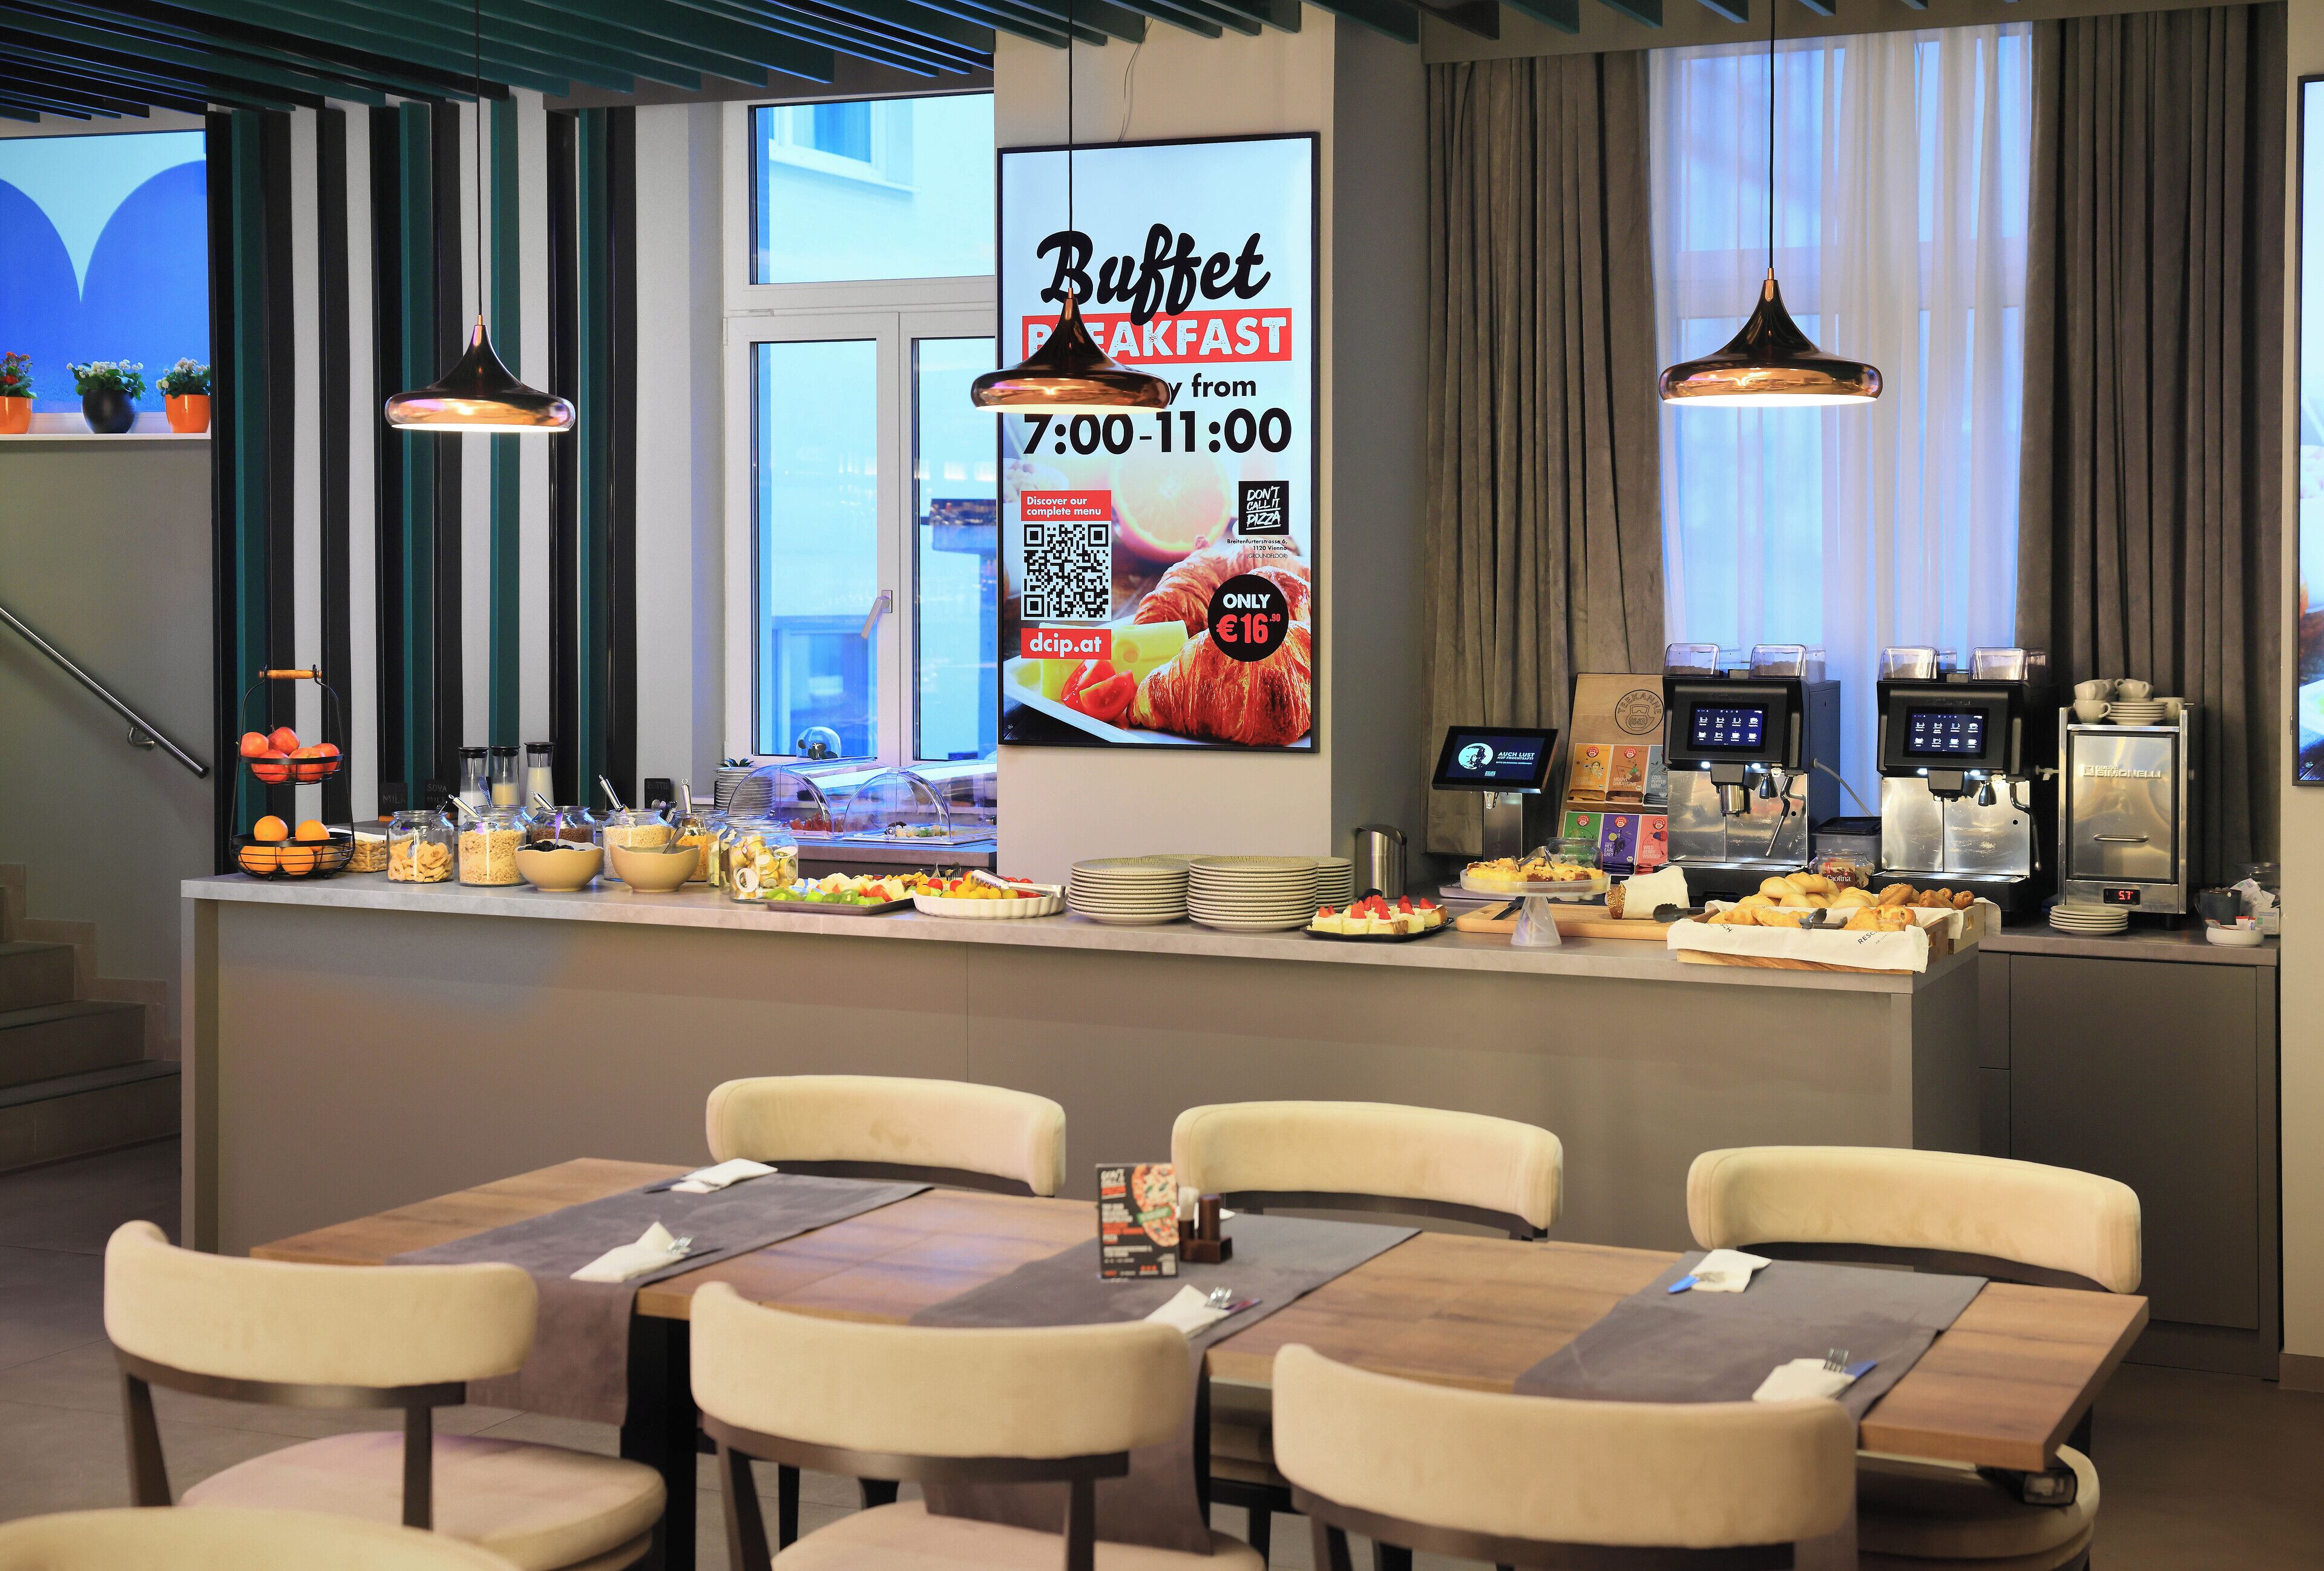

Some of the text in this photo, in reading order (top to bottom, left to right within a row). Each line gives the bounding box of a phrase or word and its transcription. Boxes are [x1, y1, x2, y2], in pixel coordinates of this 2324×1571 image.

[1037, 223, 1271, 326] Buffet
[1028, 317, 1287, 356] BEAKFAST
[1191, 373, 1256, 398] from
[1026, 496, 1068, 506] Discover
[1247, 486, 1281, 501] DON'T
[1026, 506, 1071, 518] complete
[1247, 498, 1281, 511] CALL IT
[1246, 511, 1281, 527] PIZZA
[1223, 593, 1270, 608] ONLY
[1029, 632, 1102, 657] dcip.at
[1618, 693, 1662, 714] TEEKANNE
[2096, 769, 2162, 778] SIMONELLI
[427, 783, 447, 792] SOYA
[382, 794, 407, 804] MILK
[1857, 930, 1877, 944] RESC
